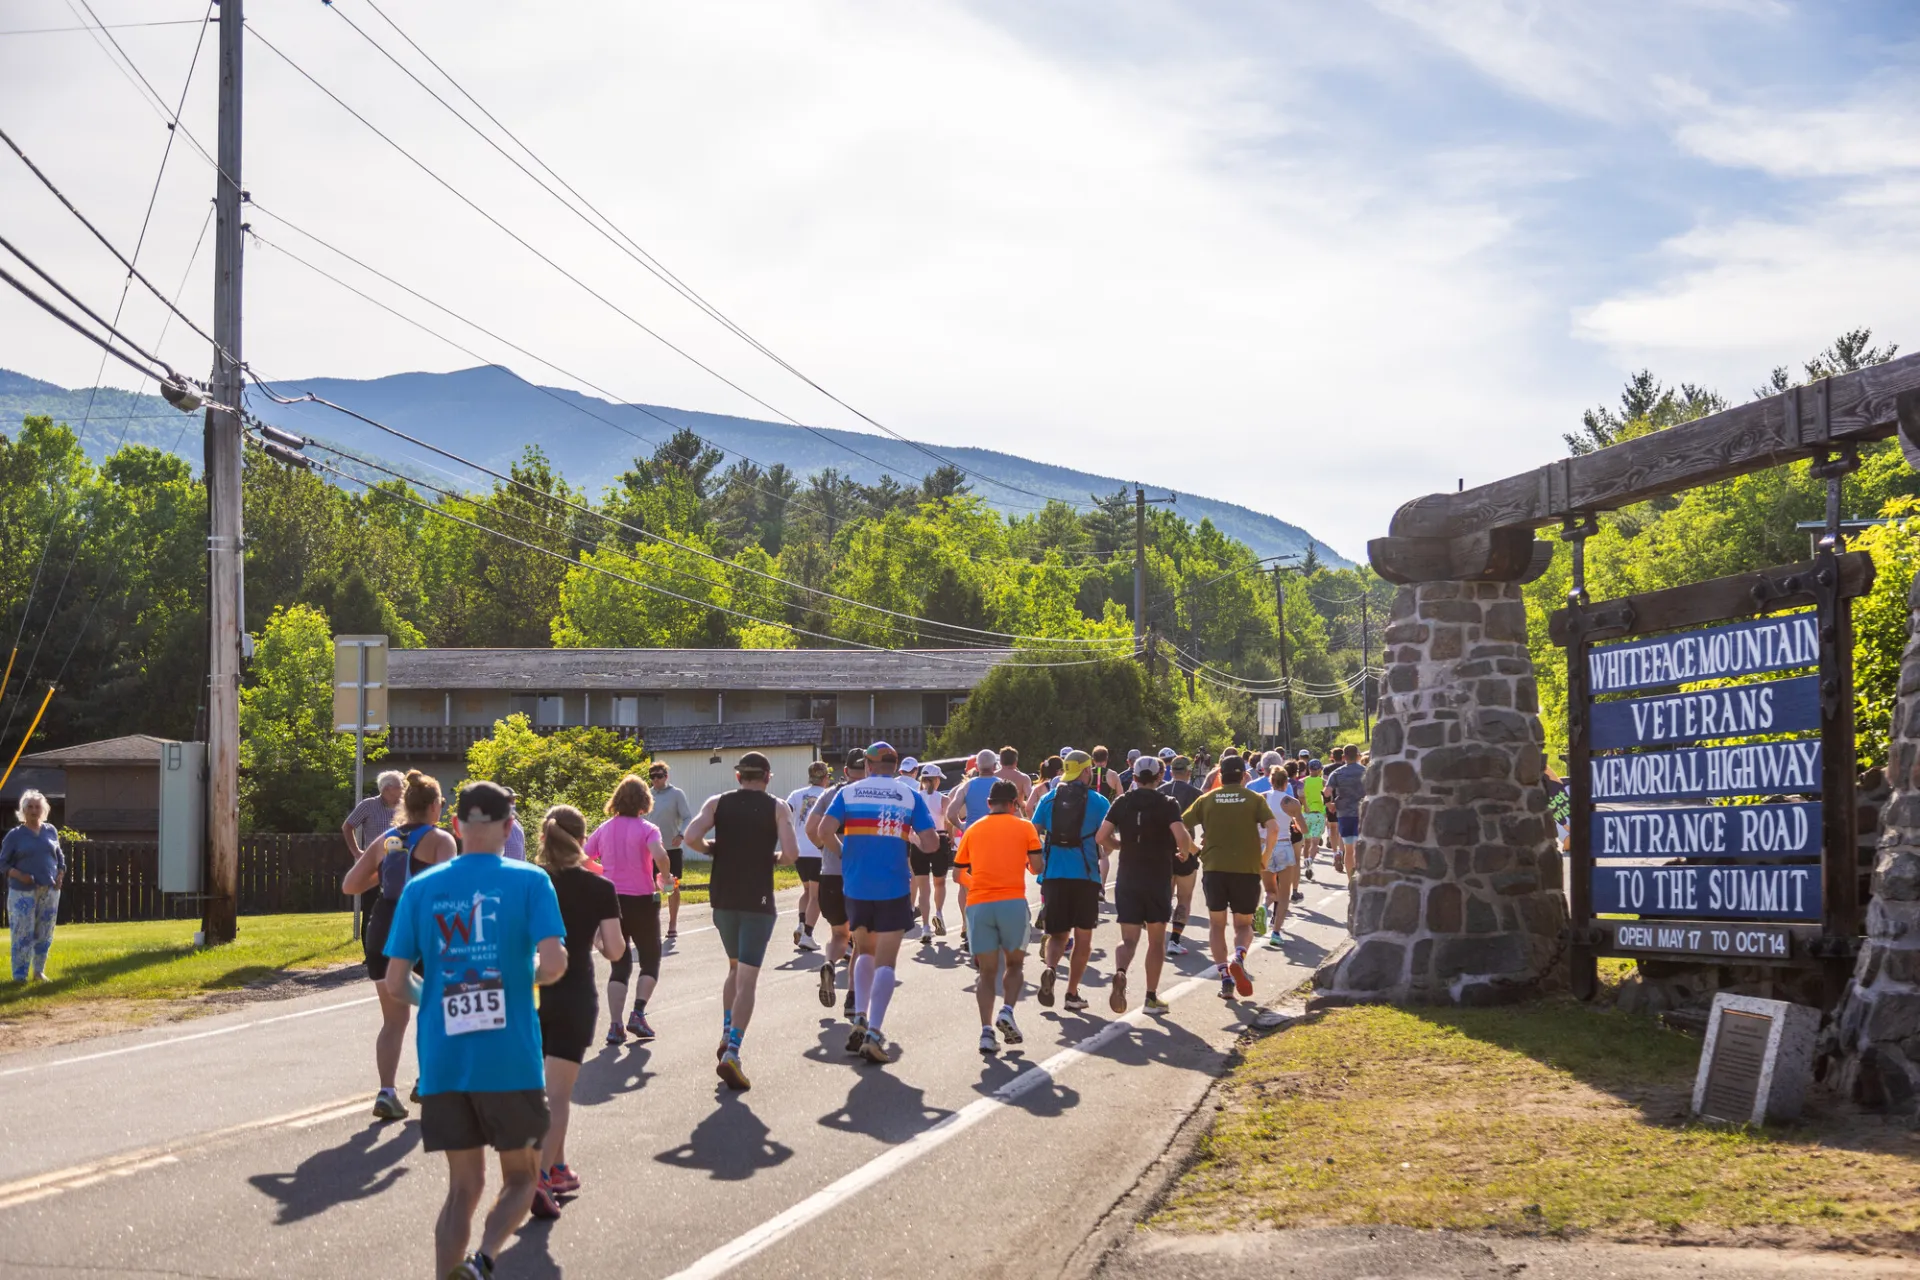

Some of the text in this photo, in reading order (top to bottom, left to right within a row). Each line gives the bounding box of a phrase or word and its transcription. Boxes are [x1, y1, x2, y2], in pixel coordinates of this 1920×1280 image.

[1588, 617, 1819, 690] WHITEFACE MOUNTAIN
[1631, 687, 1773, 741] VETERANS
[1590, 741, 1821, 798] MEMORIAL HIGHWAY
[1603, 806, 1809, 854] ENTRANCE ROAD
[1615, 868, 1809, 912] TO THE SUMMIT
[1618, 926, 1786, 954] OPEN MAY 17 TO OCT 14
[447, 991, 501, 1018] 6315
